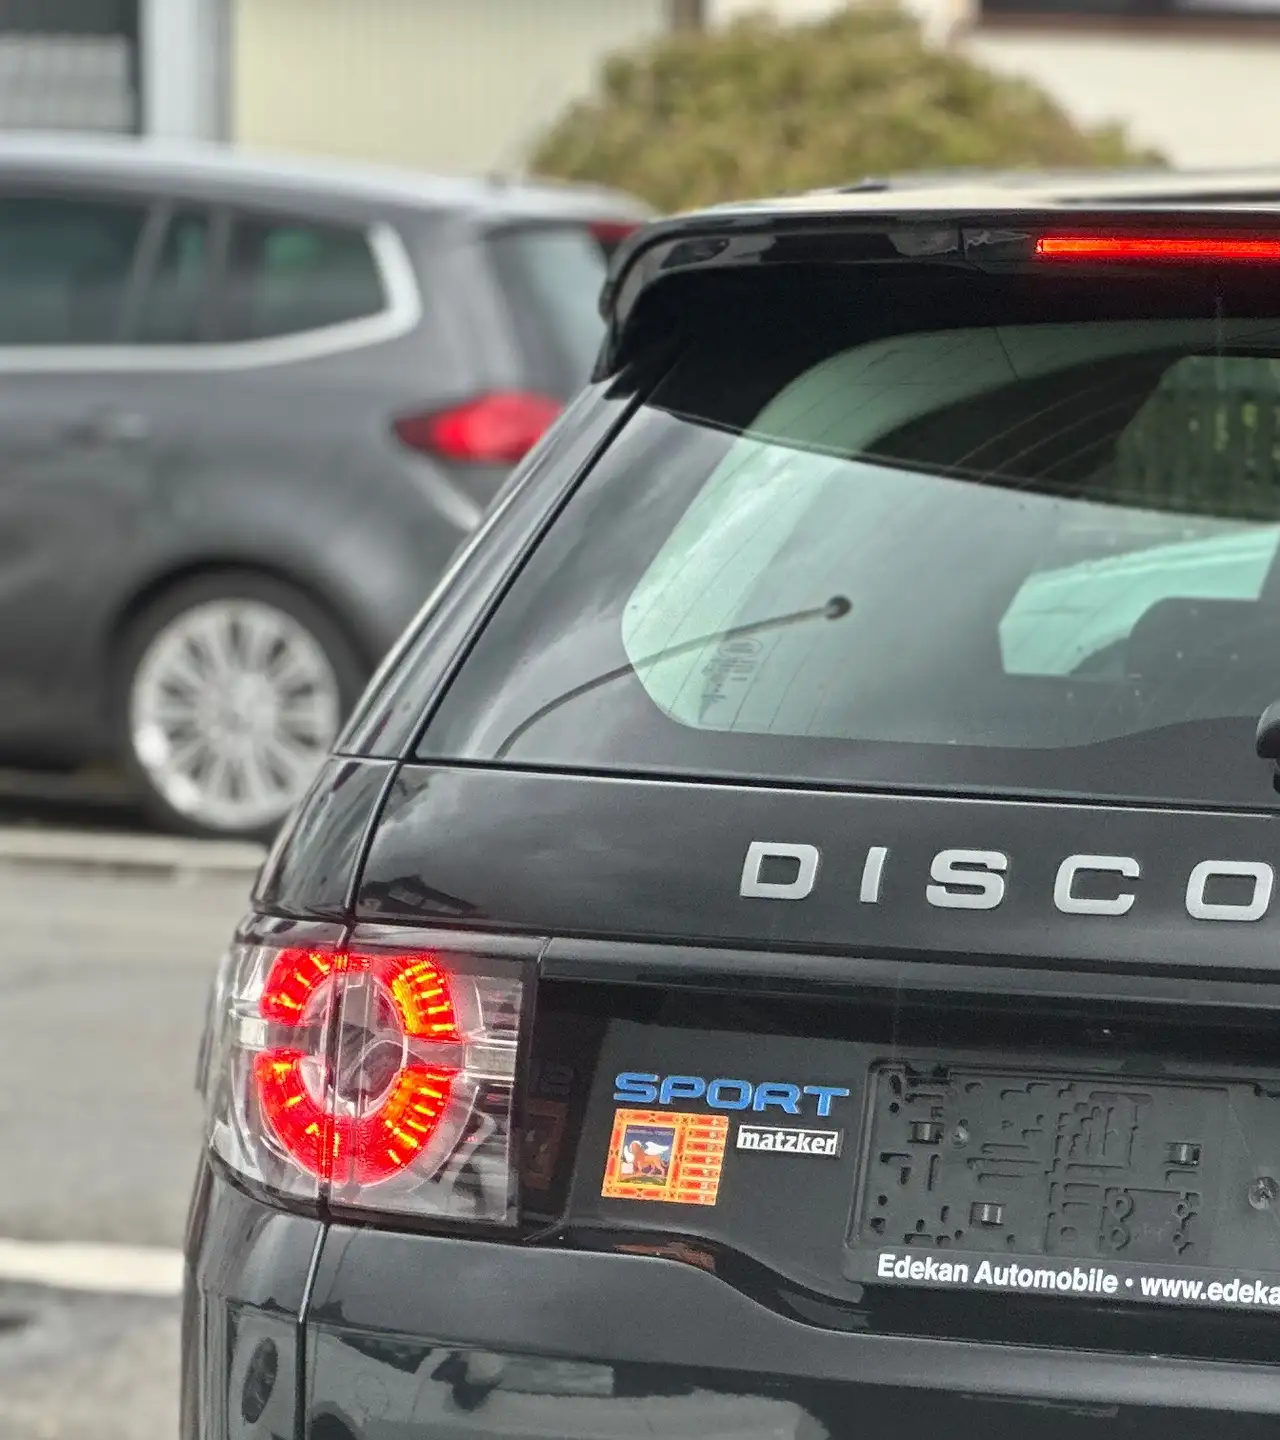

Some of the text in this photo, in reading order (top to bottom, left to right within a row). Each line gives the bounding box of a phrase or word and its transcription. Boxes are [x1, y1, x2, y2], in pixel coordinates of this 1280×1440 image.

[613, 1071, 851, 1117] SPORT
[737, 1128, 837, 1155] matzker
[877, 1253, 969, 1283] Edekan
[973, 1260, 1119, 1294] Automobile
